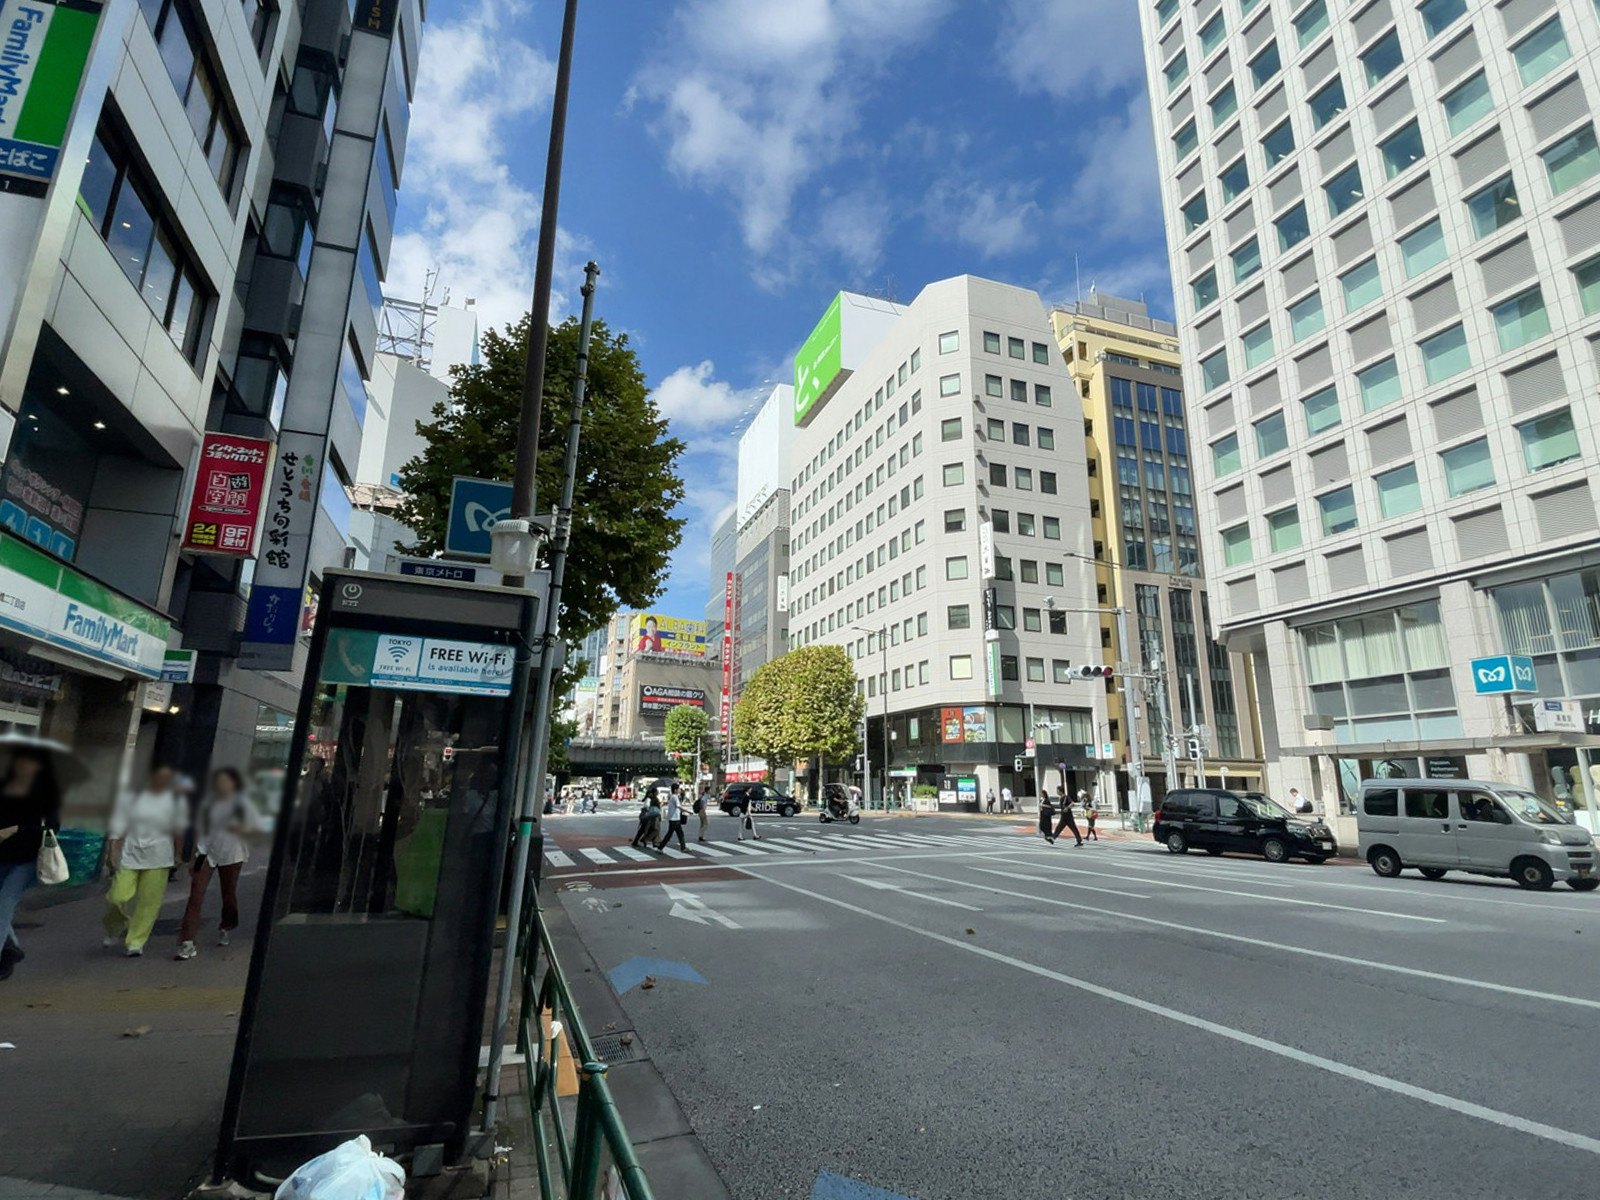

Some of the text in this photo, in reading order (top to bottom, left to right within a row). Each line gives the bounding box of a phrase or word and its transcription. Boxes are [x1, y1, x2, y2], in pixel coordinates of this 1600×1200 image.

[265, 451, 298, 569] せとうち旬彩館
[193, 523, 217, 534] 24
[225, 527, 248, 538] 9F
[414, 565, 463, 578] 東京メトロ
[63, 603, 139, 656] FamilyMart
[388, 638, 412, 647] TOKYO
[430, 647, 507, 666] FREE Wi-Fi
[427, 663, 436, 672] is
[437, 664, 479, 674] available
